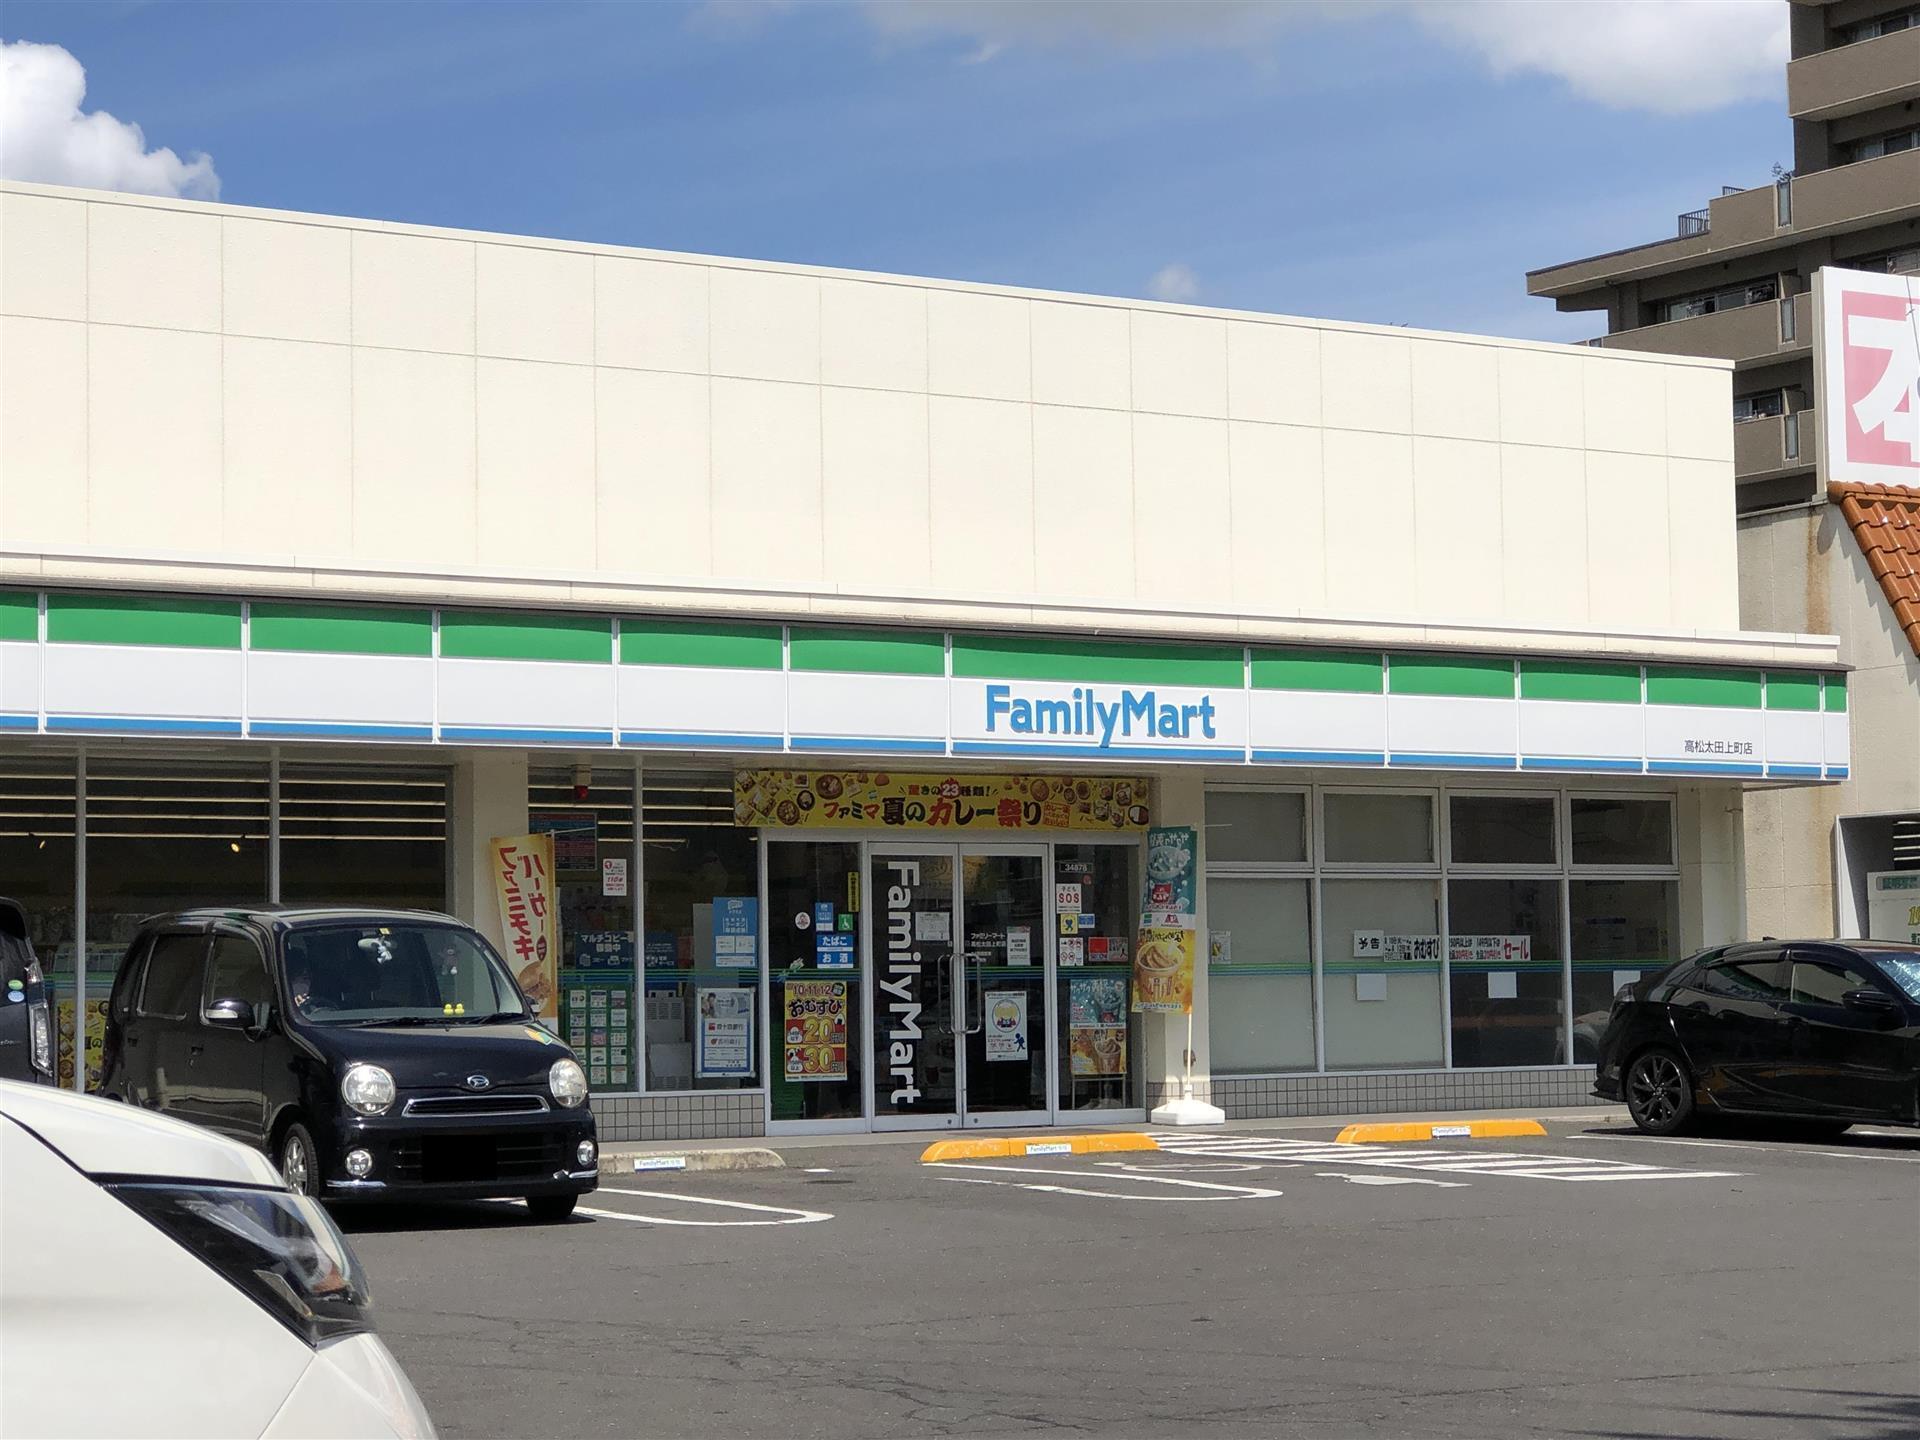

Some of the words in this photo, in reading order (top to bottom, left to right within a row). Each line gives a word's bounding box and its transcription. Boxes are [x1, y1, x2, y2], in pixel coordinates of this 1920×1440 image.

[985, 684, 1216, 748] FamilyMart
[1684, 739, 1753, 755] 高松太田上町店
[823, 797, 1042, 828] ファミマ夏のカレー祭り
[1059, 893, 1079, 903] SOS
[822, 935, 848, 946] たばこ
[1358, 937, 1380, 950] 予告
[1503, 938, 1529, 960] セール
[879, 861, 922, 1104] FamilyMart
